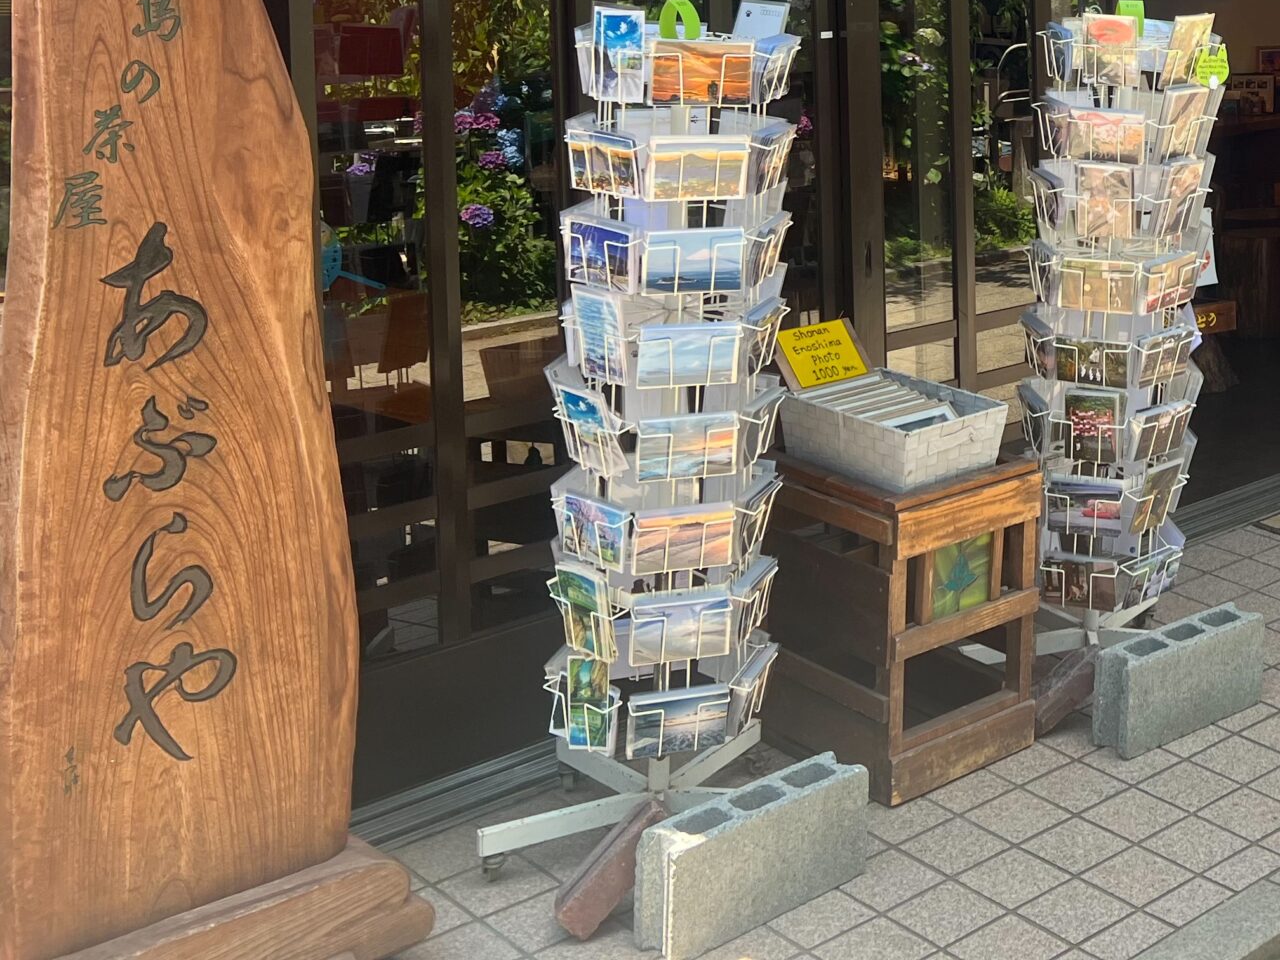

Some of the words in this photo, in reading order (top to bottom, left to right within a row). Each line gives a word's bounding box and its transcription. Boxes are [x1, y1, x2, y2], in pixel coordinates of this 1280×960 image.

[792, 339, 842, 355] Enoshima
[811, 352, 841, 366] Photo
[812, 365, 839, 381] 1000
[99, 221, 237, 761] あぶらや
